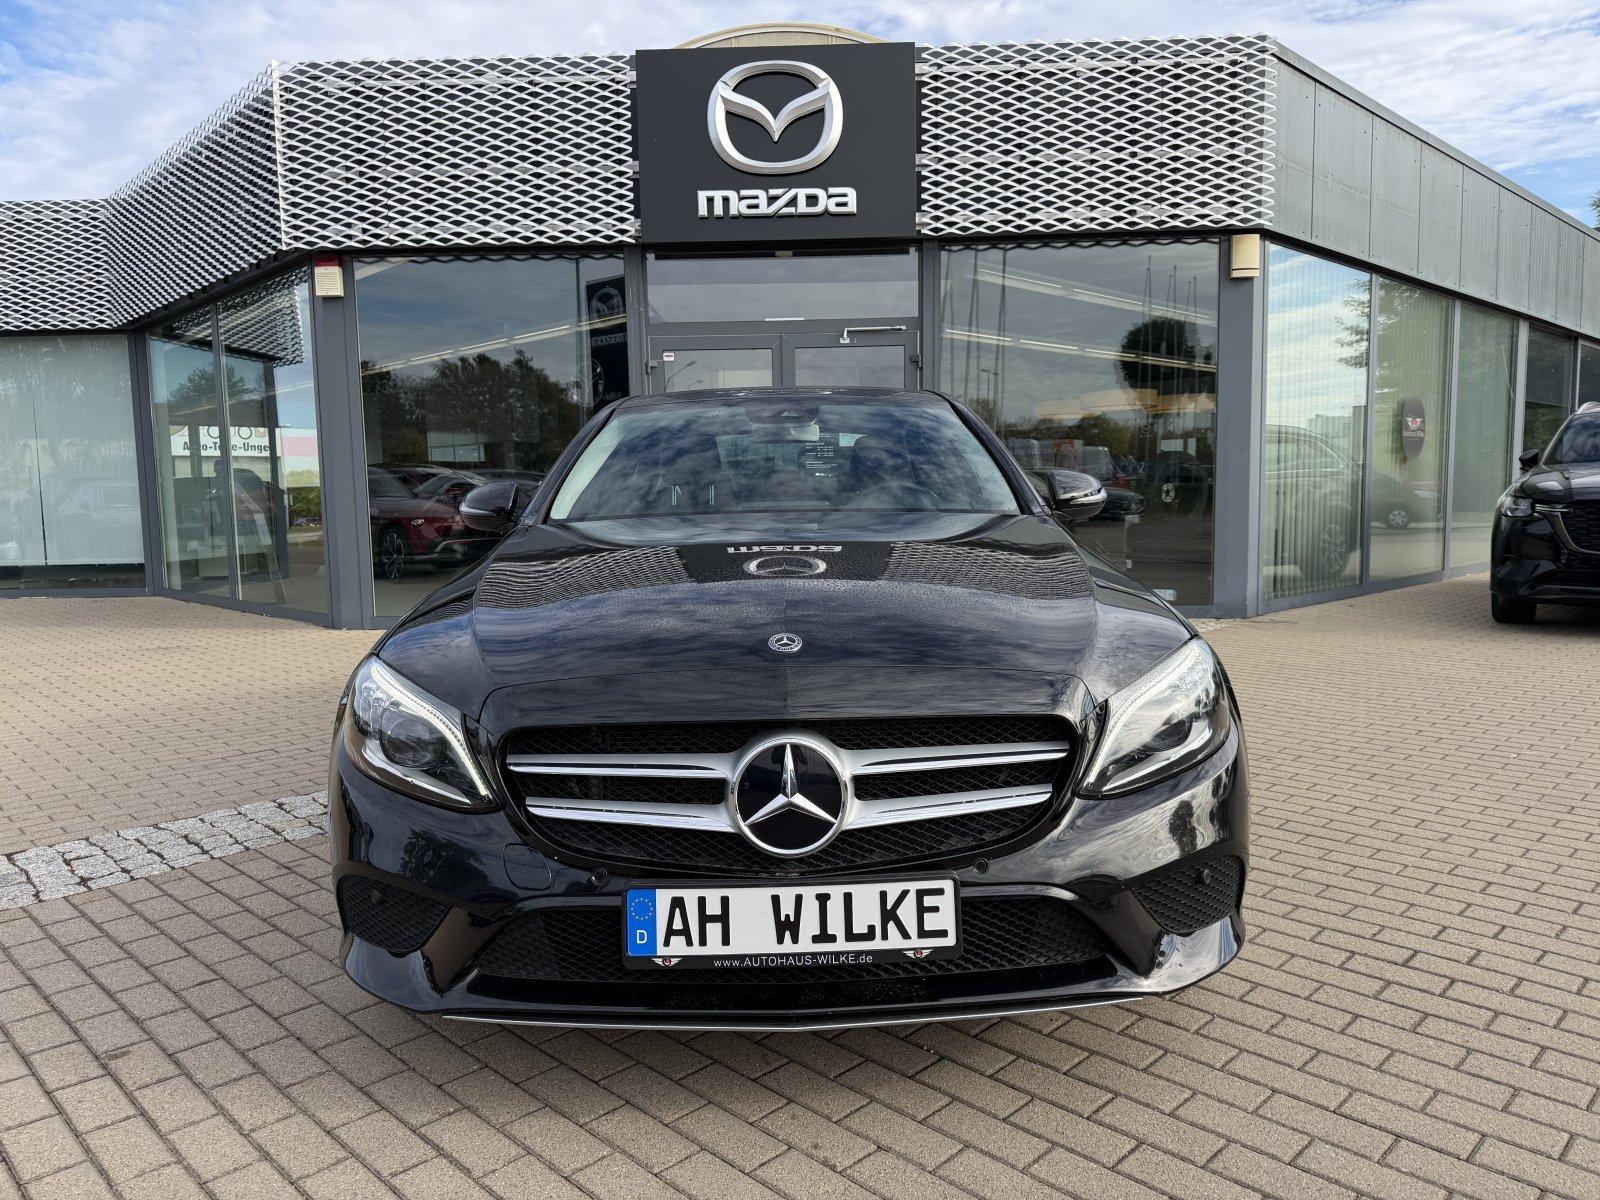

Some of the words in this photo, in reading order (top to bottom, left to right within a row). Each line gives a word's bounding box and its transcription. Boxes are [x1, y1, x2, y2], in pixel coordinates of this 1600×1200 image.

[663, 896, 731, 947] AH
[771, 887, 949, 945] WILKE
[636, 929, 647, 944] D
[713, 953, 873, 968] www.AUTOHAUS-WILKE.de
